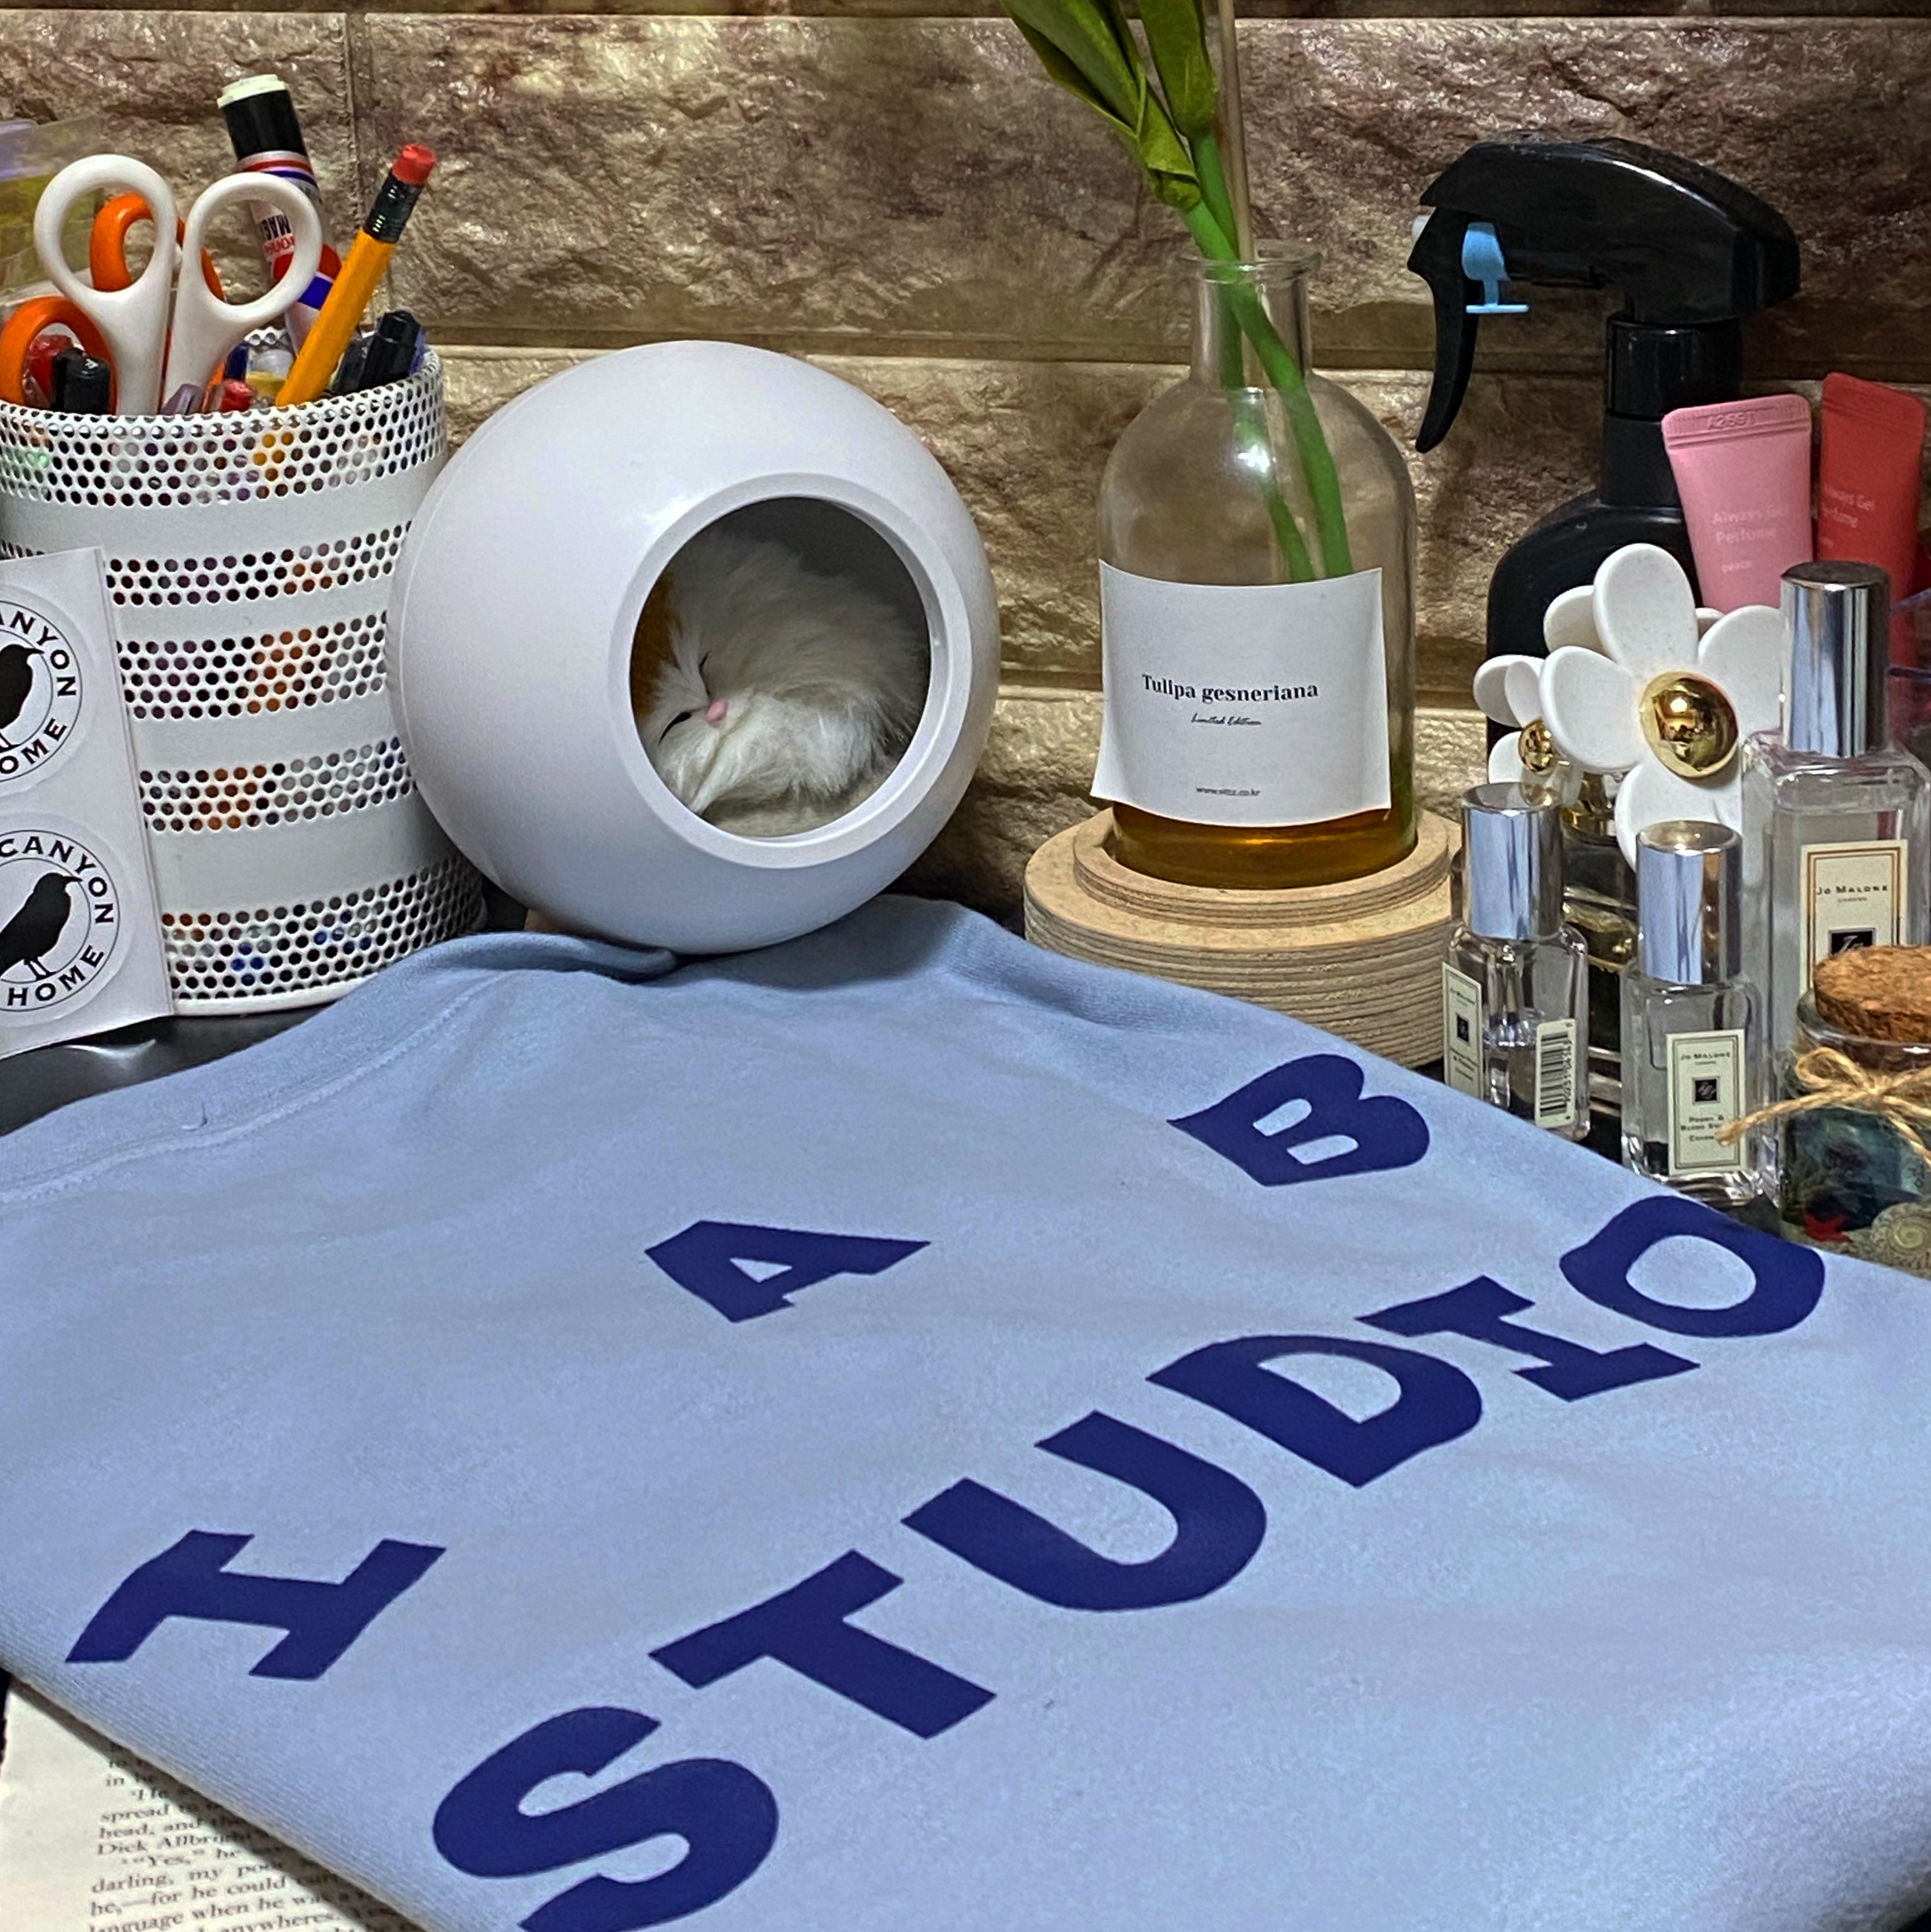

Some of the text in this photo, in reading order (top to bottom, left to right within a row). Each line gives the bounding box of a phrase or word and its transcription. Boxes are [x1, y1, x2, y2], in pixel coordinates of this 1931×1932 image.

[1715, 528, 1777, 544] Perfume
[1142, 673, 1319, 704] Tulipa gesneriana
[0, 835, 115, 924] CANYON
[7, 945, 105, 1007] HOME
[431, 1194, 1826, 1932] STUDIO
[101, 1803, 170, 1823] spread
[100, 1823, 155, 1839] head,
[98, 1839, 148, 1855] Dick
[91, 1873, 174, 1893] darling,
[188, 1867, 222, 1881] my
[226, 1876, 287, 1895] could
[192, 1903, 250, 1919] when
[259, 1898, 282, 1911] he
